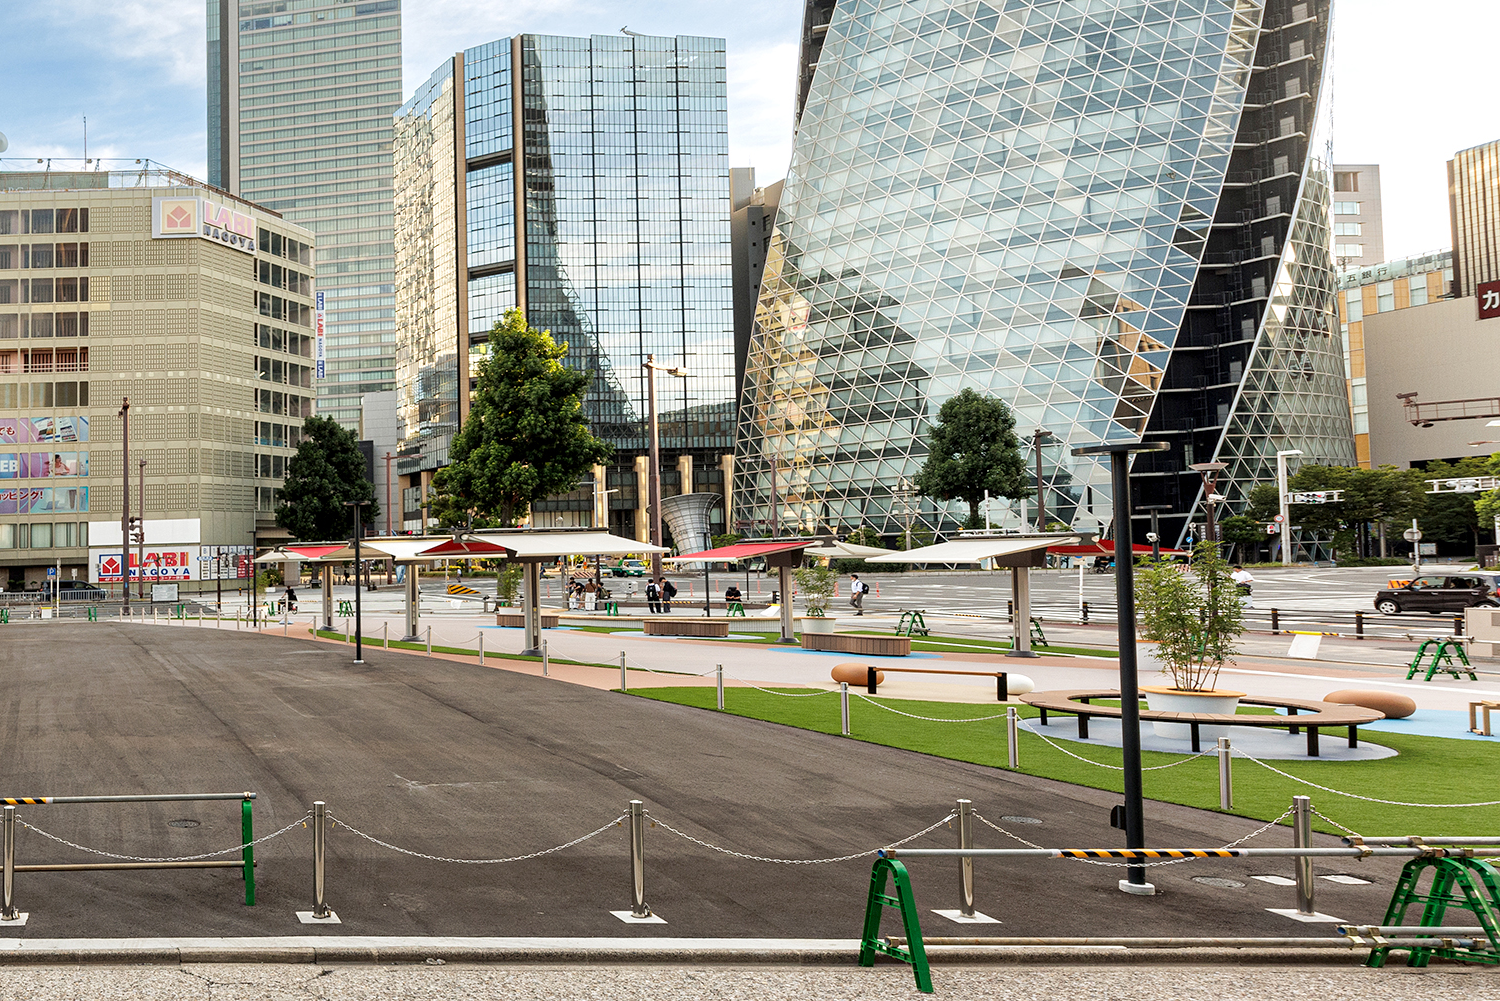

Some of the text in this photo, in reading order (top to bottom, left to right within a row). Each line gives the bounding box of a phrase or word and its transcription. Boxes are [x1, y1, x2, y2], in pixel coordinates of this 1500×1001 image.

[204, 200, 257, 241] LABI
[203, 225, 255, 251] NAGOYA
[129, 552, 188, 567] LABI
[129, 568, 190, 576] NAGOYA
